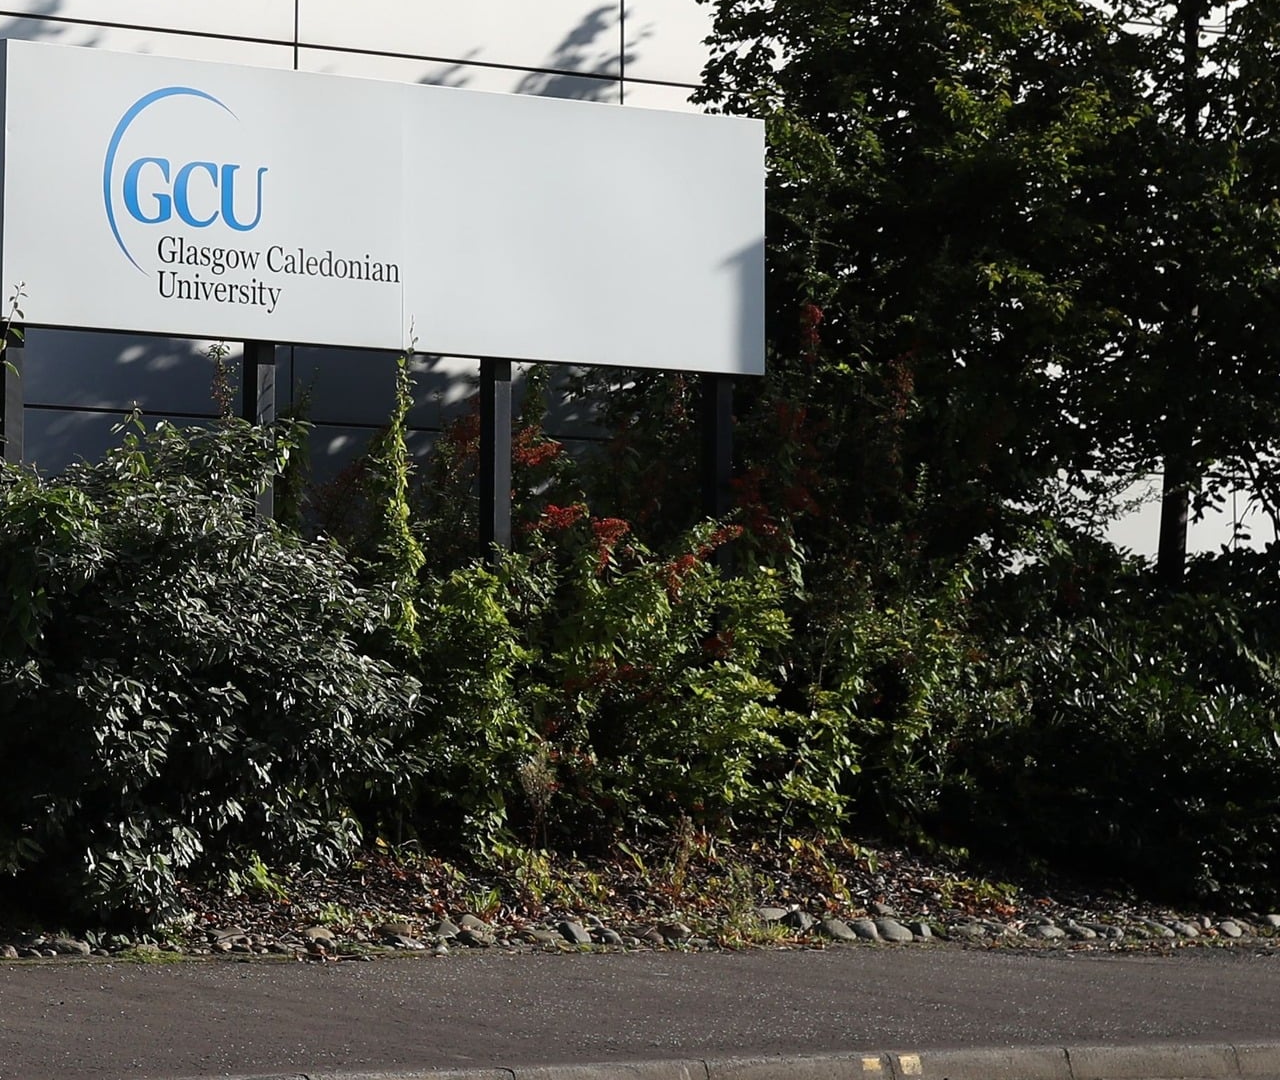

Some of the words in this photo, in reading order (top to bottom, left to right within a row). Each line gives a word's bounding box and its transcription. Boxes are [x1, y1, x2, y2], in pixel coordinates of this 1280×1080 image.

[123, 157, 268, 231] GCU
[157, 235, 261, 276] Glasgow
[267, 246, 401, 283] Caledonian
[157, 270, 282, 314] University
